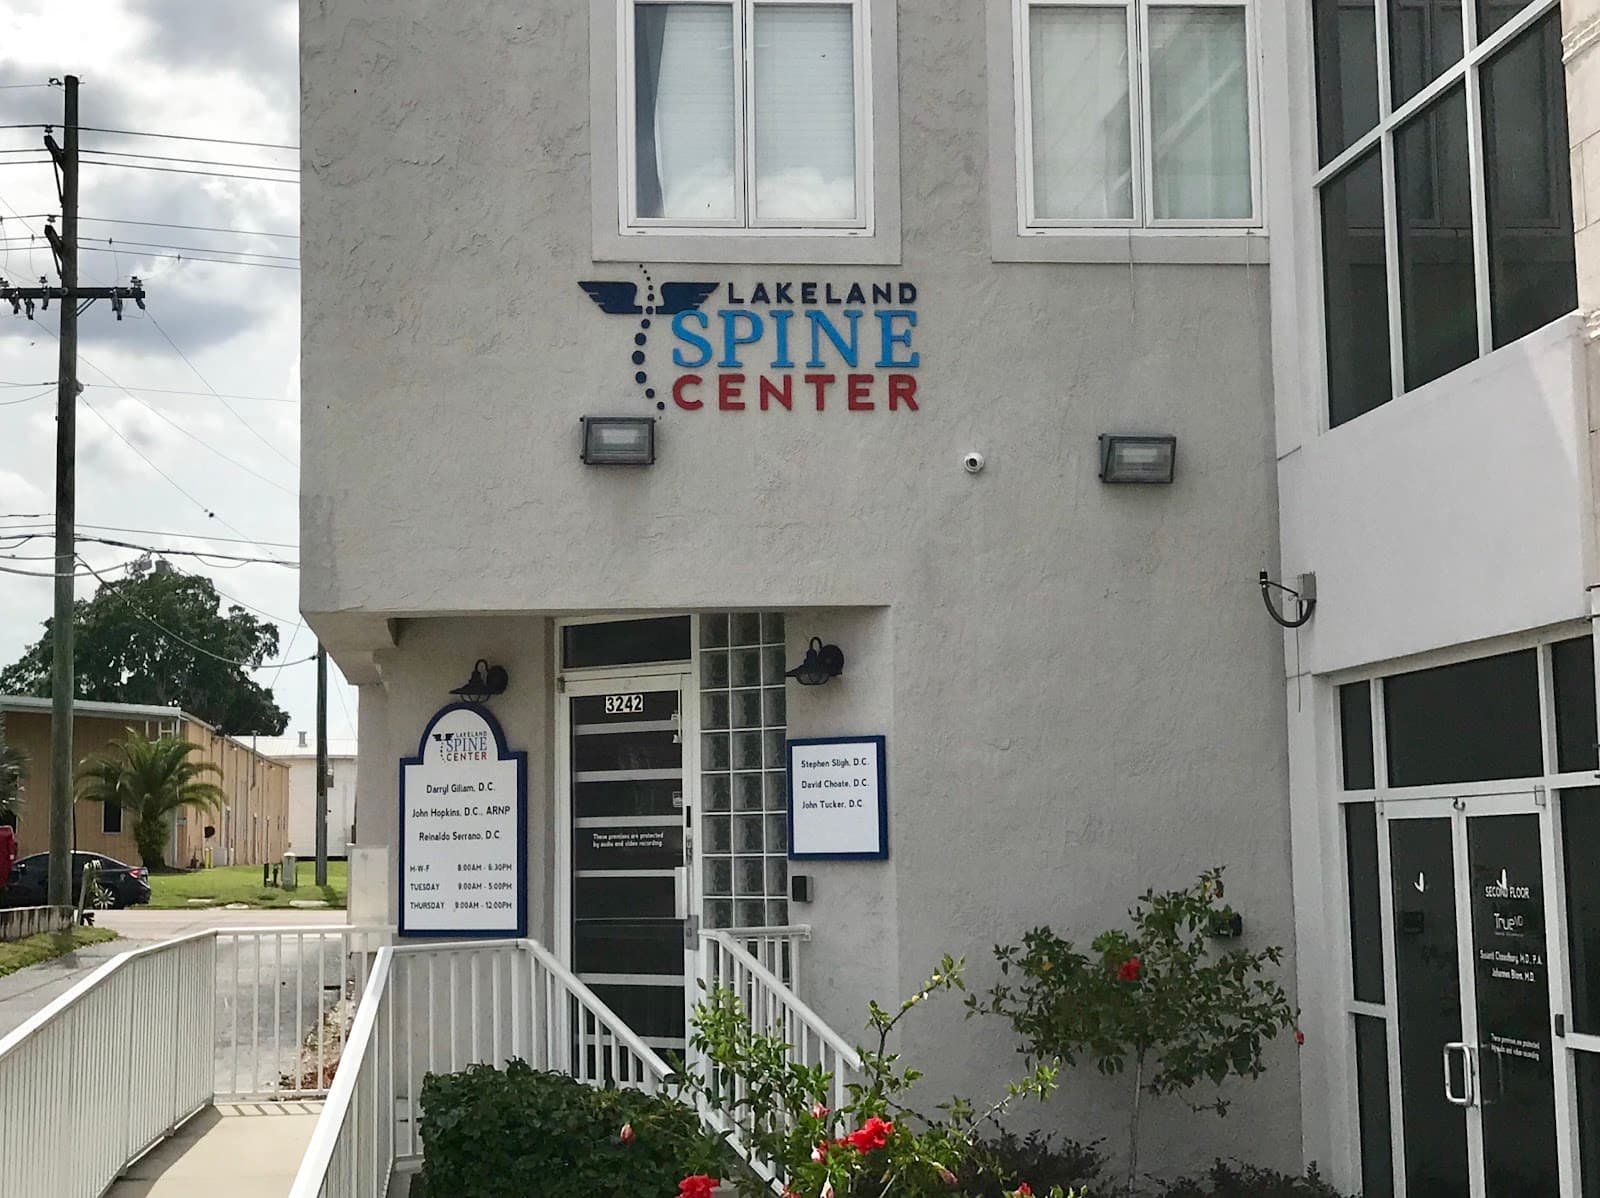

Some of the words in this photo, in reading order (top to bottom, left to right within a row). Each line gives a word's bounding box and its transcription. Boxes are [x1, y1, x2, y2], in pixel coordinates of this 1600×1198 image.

[728, 282, 917, 304] LAKELAND
[671, 309, 920, 369] SPINE
[672, 374, 919, 412] CENTER
[606, 695, 642, 712] 3242
[446, 736, 488, 752] SPINE
[446, 751, 487, 761] CENTER
[801, 760, 830, 769] Stephen
[426, 784, 449, 795] Darryl
[801, 780, 822, 789] David
[801, 801, 818, 809] John
[412, 808, 429, 818] John
[486, 805, 510, 815] ARNP
[419, 831, 450, 841] Reinaldo
[410, 882, 440, 891] TUESDAY
[1509, 886, 1530, 899] FLOOR
[410, 901, 444, 910] THURSDAY
